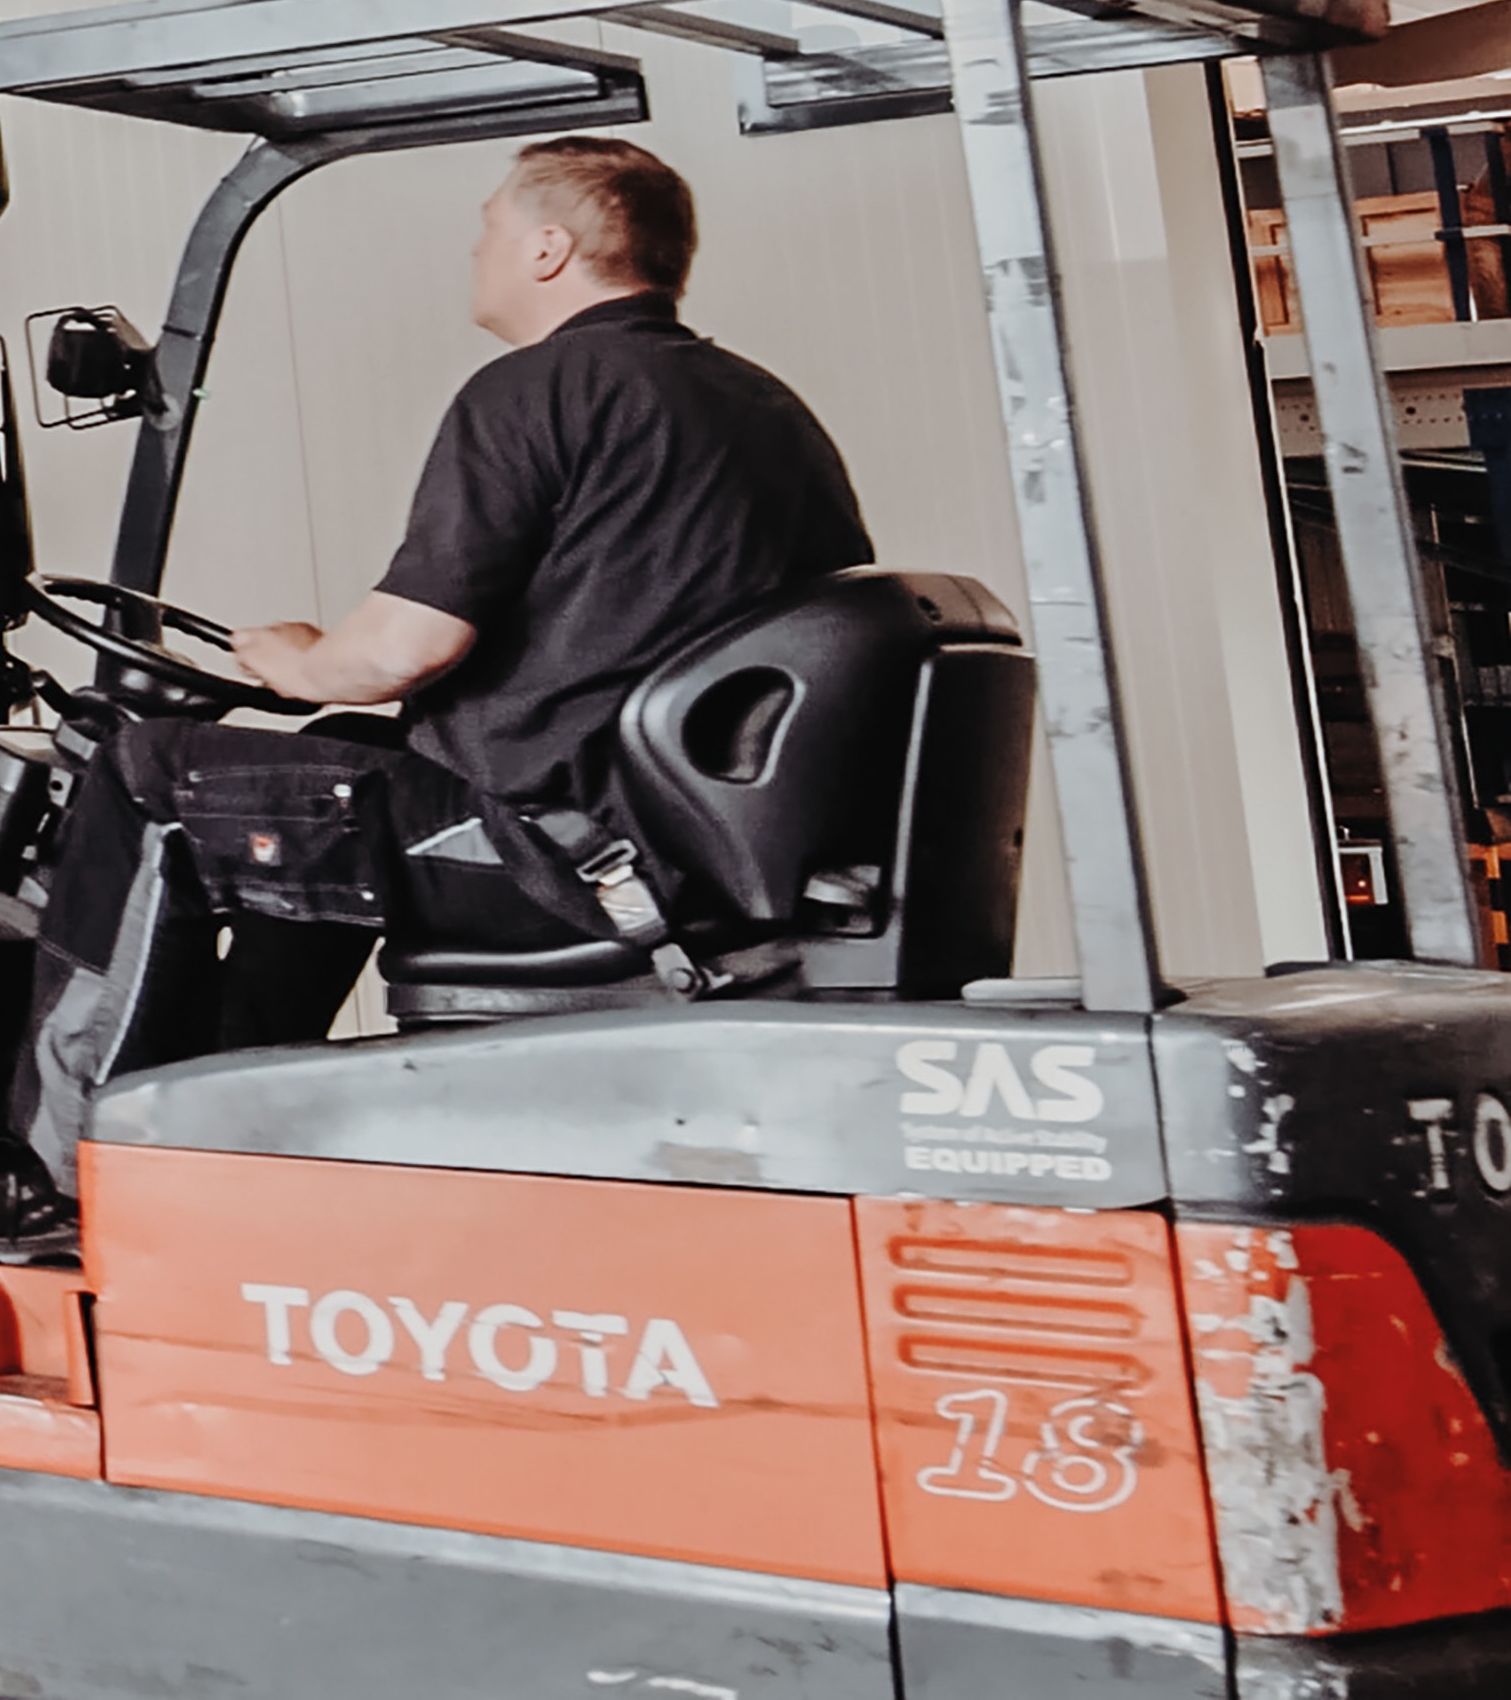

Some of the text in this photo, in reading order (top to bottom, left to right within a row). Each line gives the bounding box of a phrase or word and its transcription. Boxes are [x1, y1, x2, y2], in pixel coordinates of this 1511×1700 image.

[895, 1040, 1105, 1123] SAS
[904, 1146, 1113, 1182] EQUIPPED
[240, 1282, 720, 1409] TOYOTA
[916, 1387, 1145, 1512] 18
